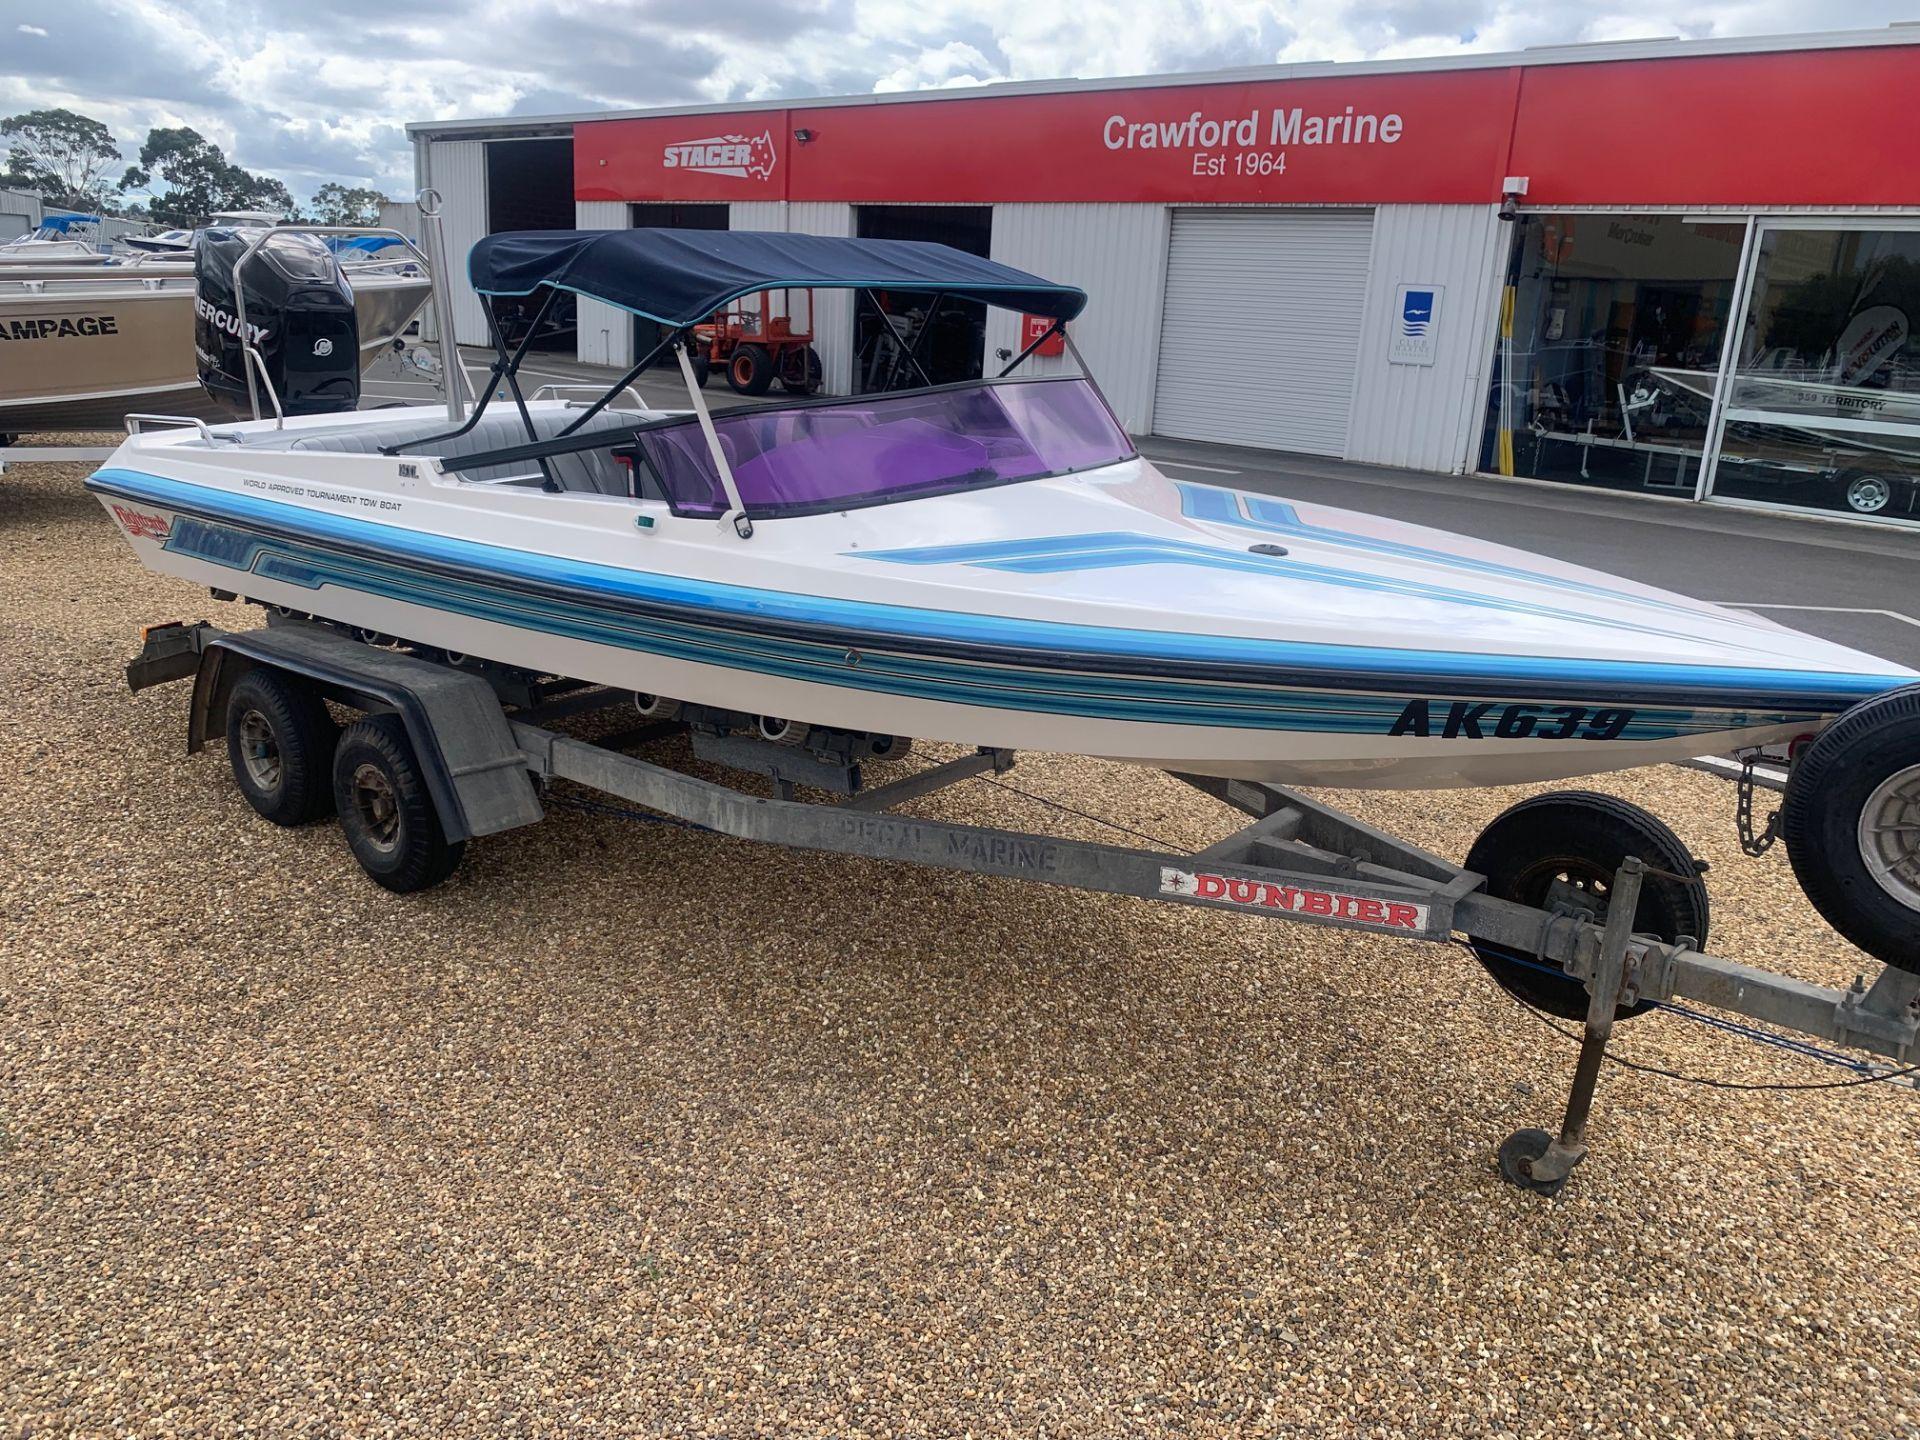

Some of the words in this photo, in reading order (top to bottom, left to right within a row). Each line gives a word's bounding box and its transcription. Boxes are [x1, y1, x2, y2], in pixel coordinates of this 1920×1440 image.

[1103, 110, 1259, 149] Crawford
[1270, 106, 1403, 145] Marine
[663, 144, 752, 168] STACER
[1192, 153, 1226, 176] Est
[1234, 151, 1287, 176] 1964
[1822, 395, 1887, 411] TERRITORY
[243, 478, 267, 490] WORLD
[268, 483, 304, 496] APPROVED
[306, 489, 357, 505] TOURNAMENT
[359, 497, 378, 508] TOW
[379, 501, 402, 512] BOAT
[1387, 699, 1637, 741] AK639
[948, 831, 1058, 872] MARINE
[1193, 872, 1419, 930] DUNBIER
